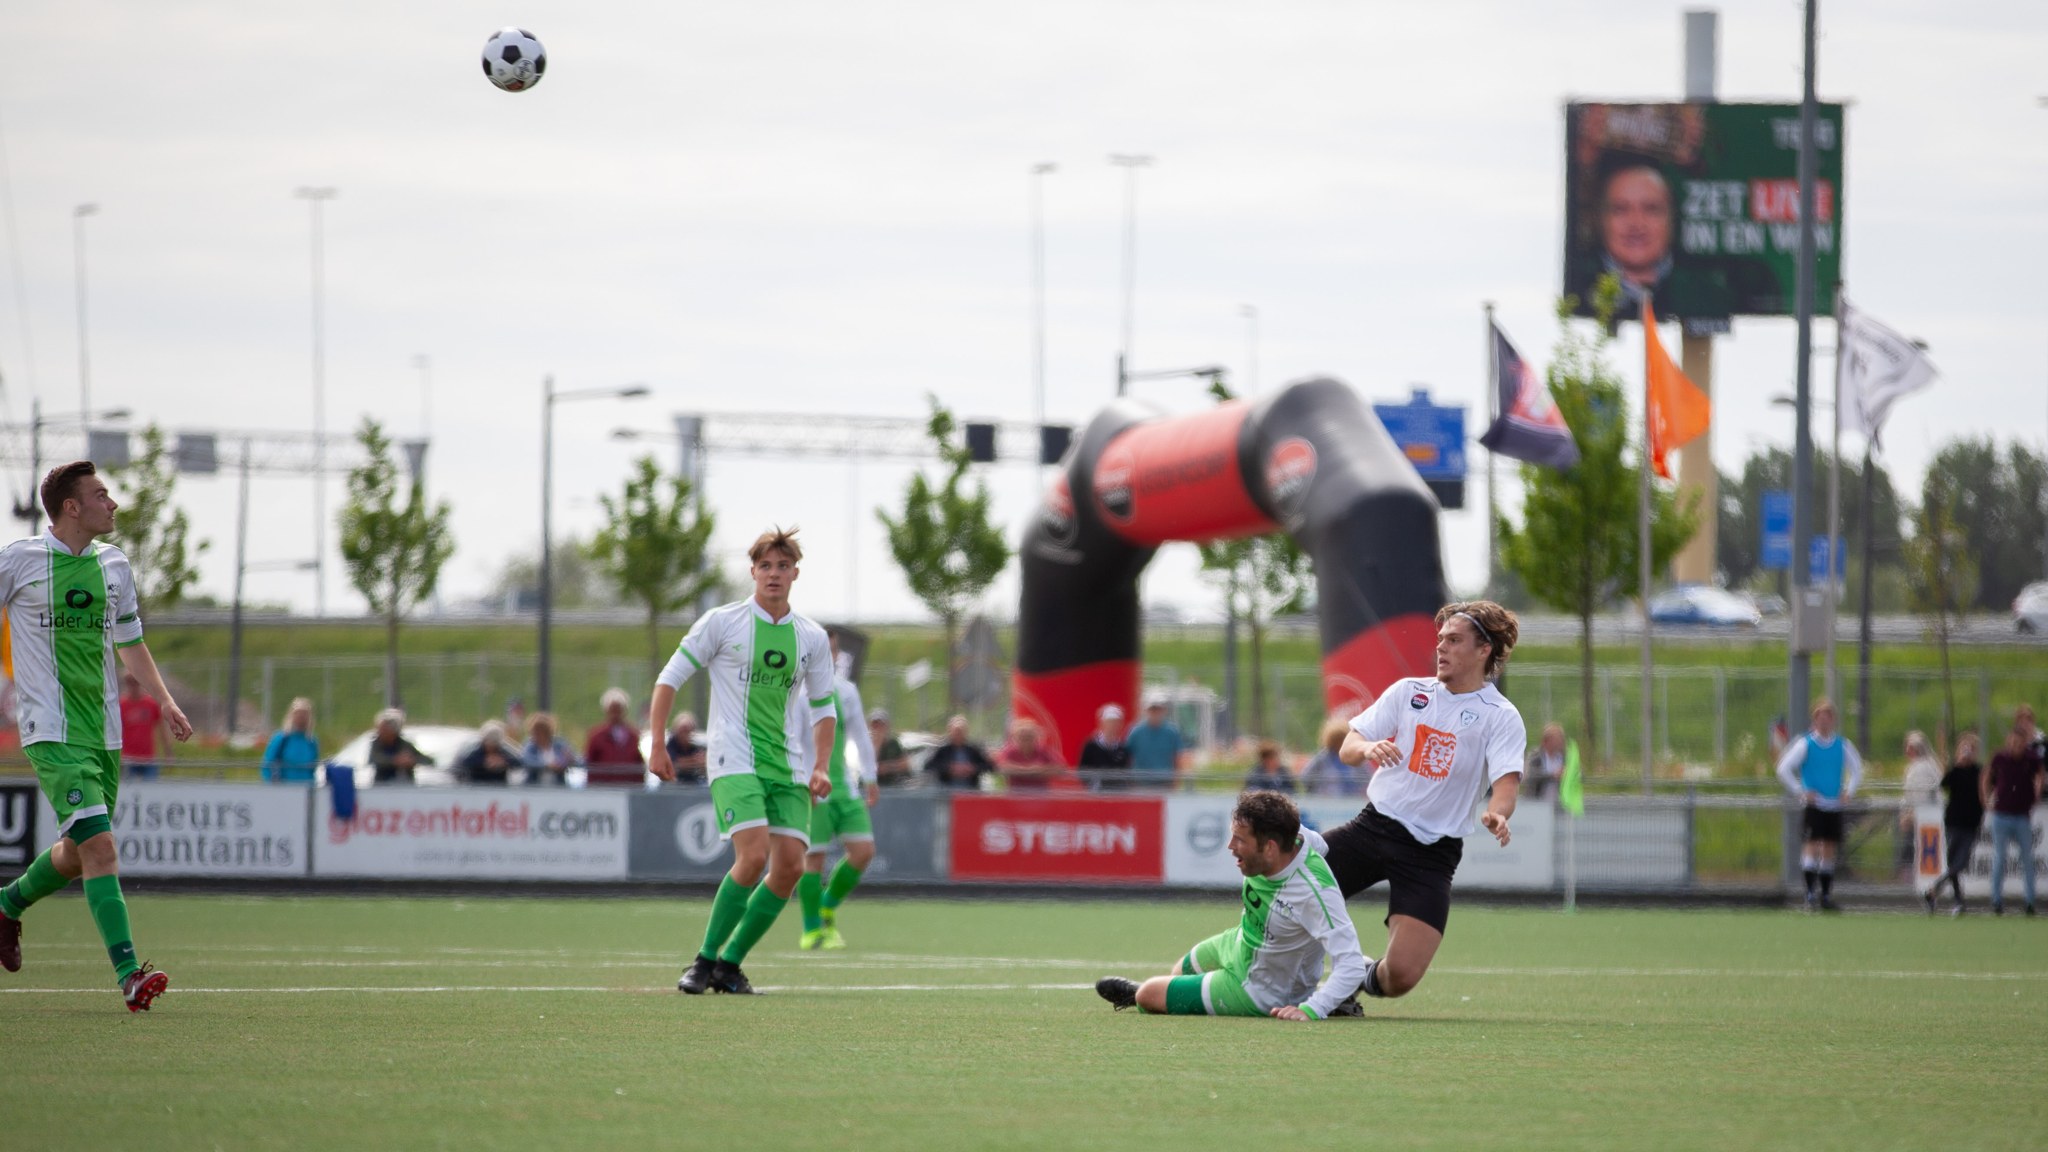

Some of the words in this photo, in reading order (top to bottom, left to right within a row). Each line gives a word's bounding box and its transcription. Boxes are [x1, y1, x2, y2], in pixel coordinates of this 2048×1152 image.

[1768, 223, 1833, 254] WN
[40, 612, 82, 629] Lider
[739, 667, 775, 685] Lider
[112, 794, 252, 832] viseurs
[328, 801, 618, 844] glazentafel.com
[118, 830, 294, 868] ountants
[981, 821, 1137, 855] STERN
